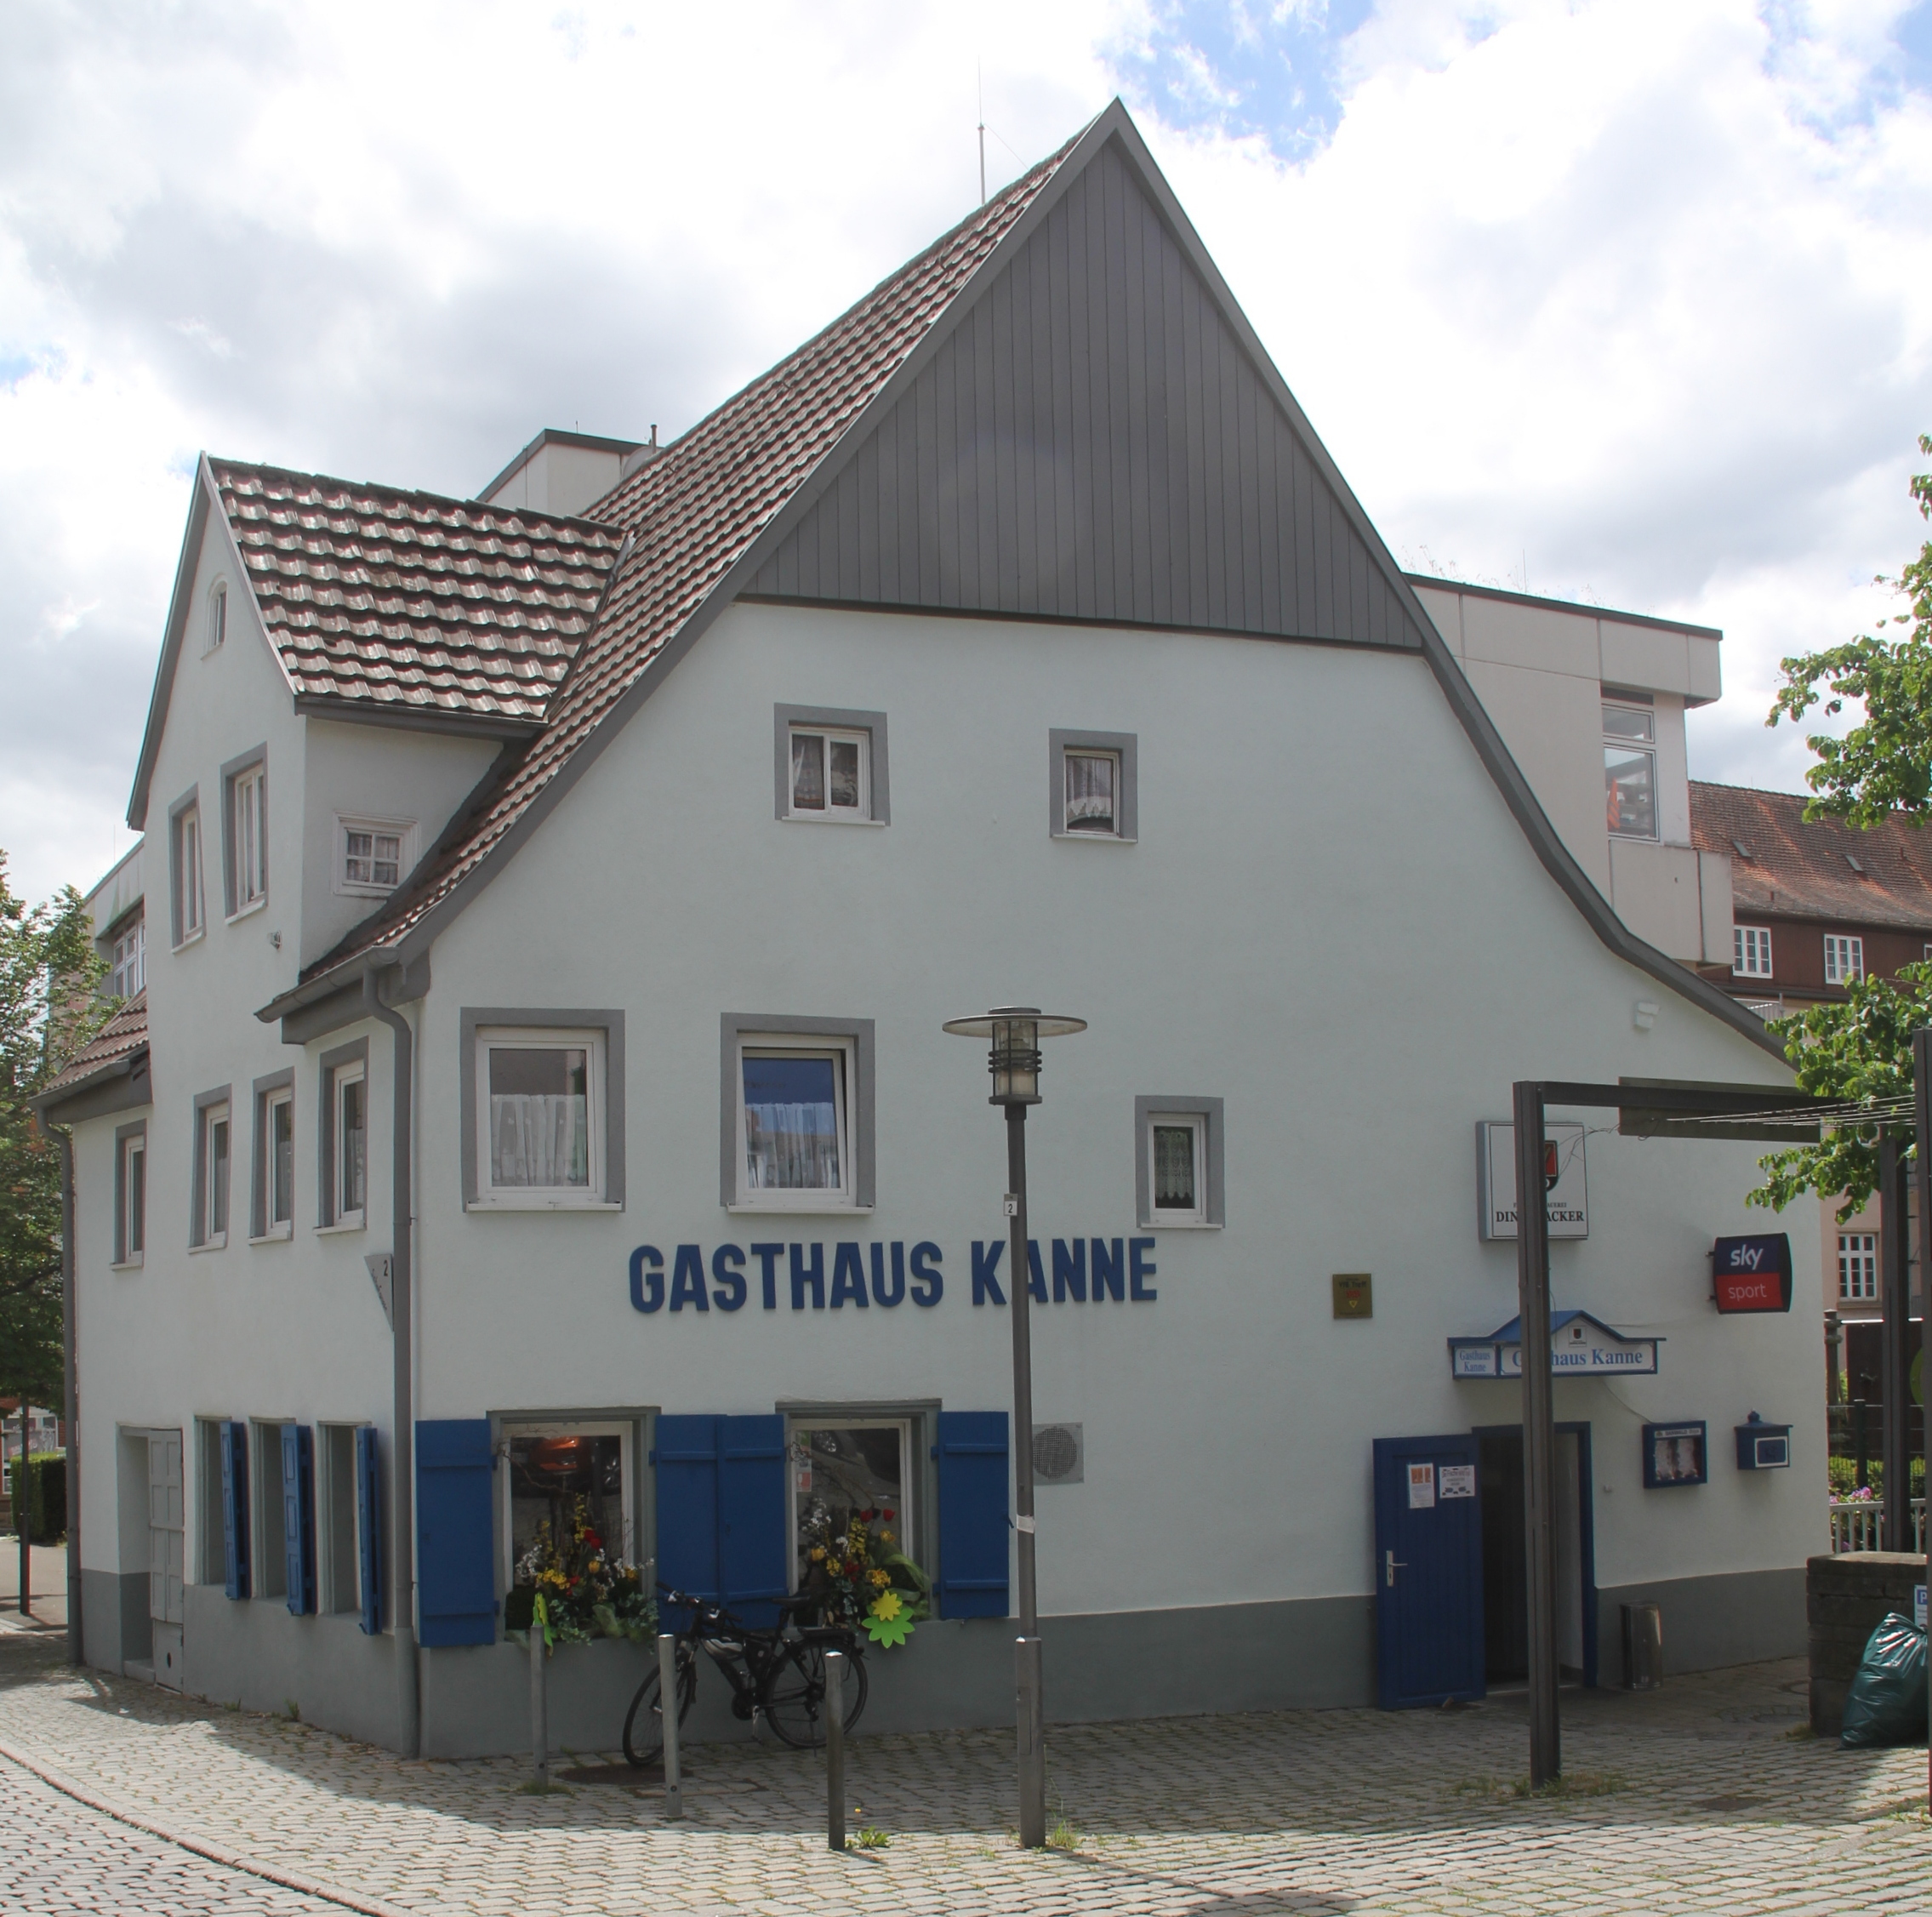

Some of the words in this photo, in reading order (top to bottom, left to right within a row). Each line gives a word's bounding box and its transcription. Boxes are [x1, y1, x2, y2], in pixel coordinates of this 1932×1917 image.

[1008, 1203, 1013, 1213] 2
[1496, 1210, 1585, 1223] DINACKER
[1730, 1243, 1764, 1271] sky
[384, 1259, 389, 1276] 2
[629, 1240, 943, 1315] GASTHAUS
[971, 1236, 1158, 1308] KANNE
[1727, 1283, 1768, 1303] sport
[1459, 1349, 1491, 1361] Gasthaus
[1512, 1349, 1587, 1367] Ghaus
[1591, 1348, 1644, 1366] Kanne
[1463, 1361, 1487, 1372] Kanne
